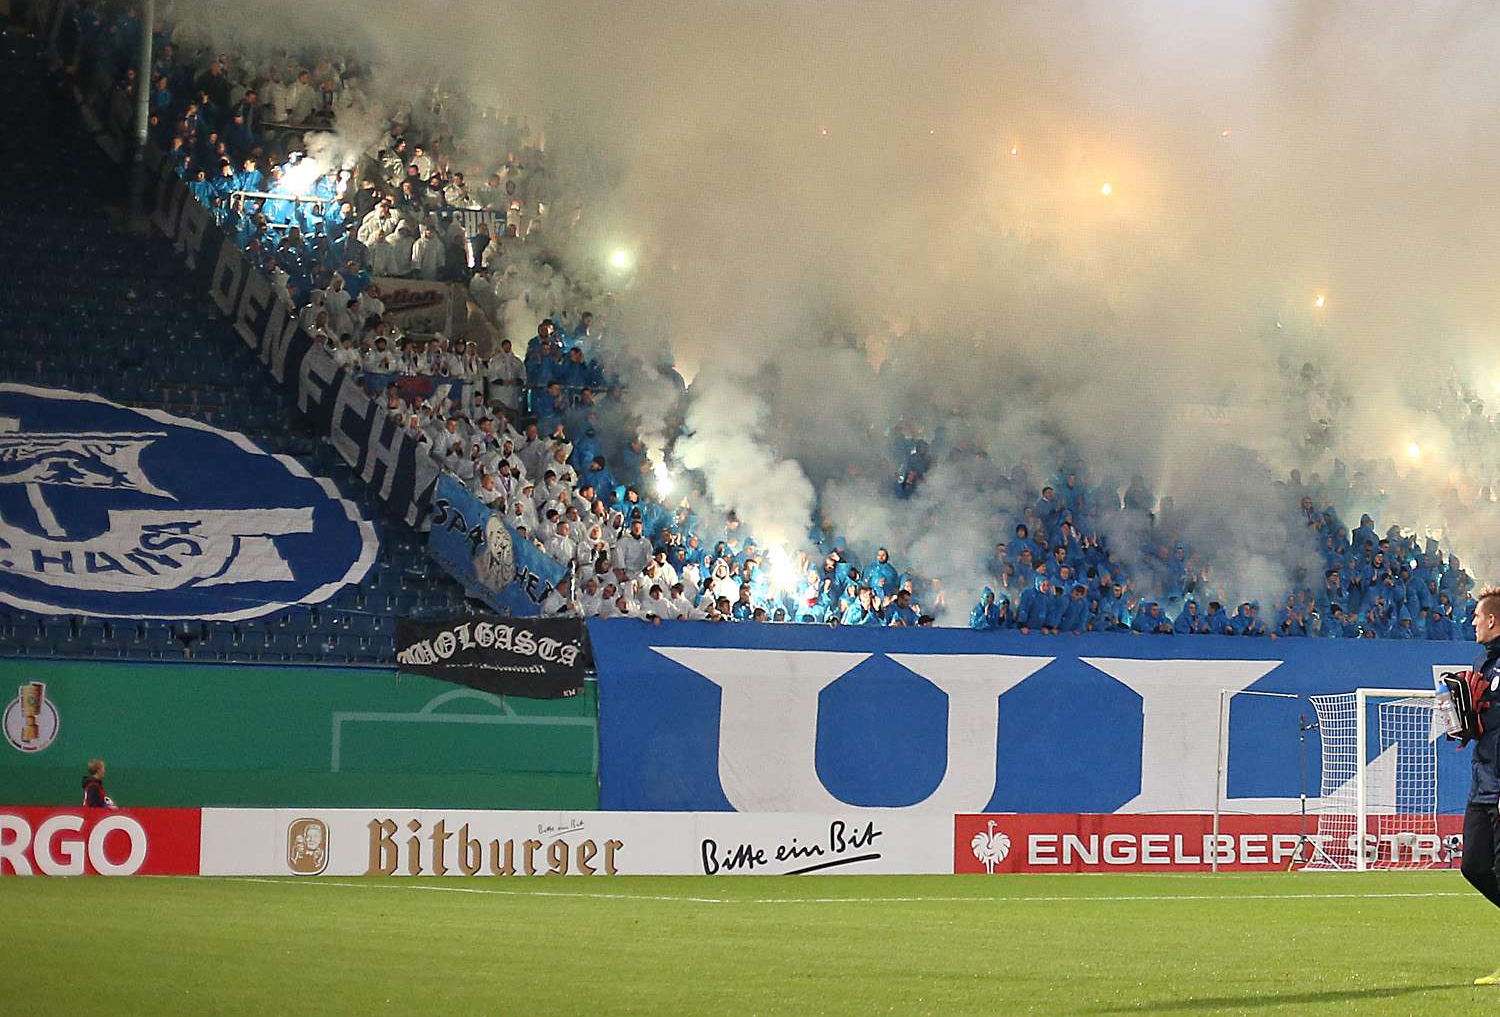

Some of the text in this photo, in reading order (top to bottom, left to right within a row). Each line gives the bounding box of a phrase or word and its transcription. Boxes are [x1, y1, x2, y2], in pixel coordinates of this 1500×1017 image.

[210, 237, 301, 383] DEN
[365, 818, 624, 876] Bitburger
[701, 820, 882, 875] Bitte ein Bit
